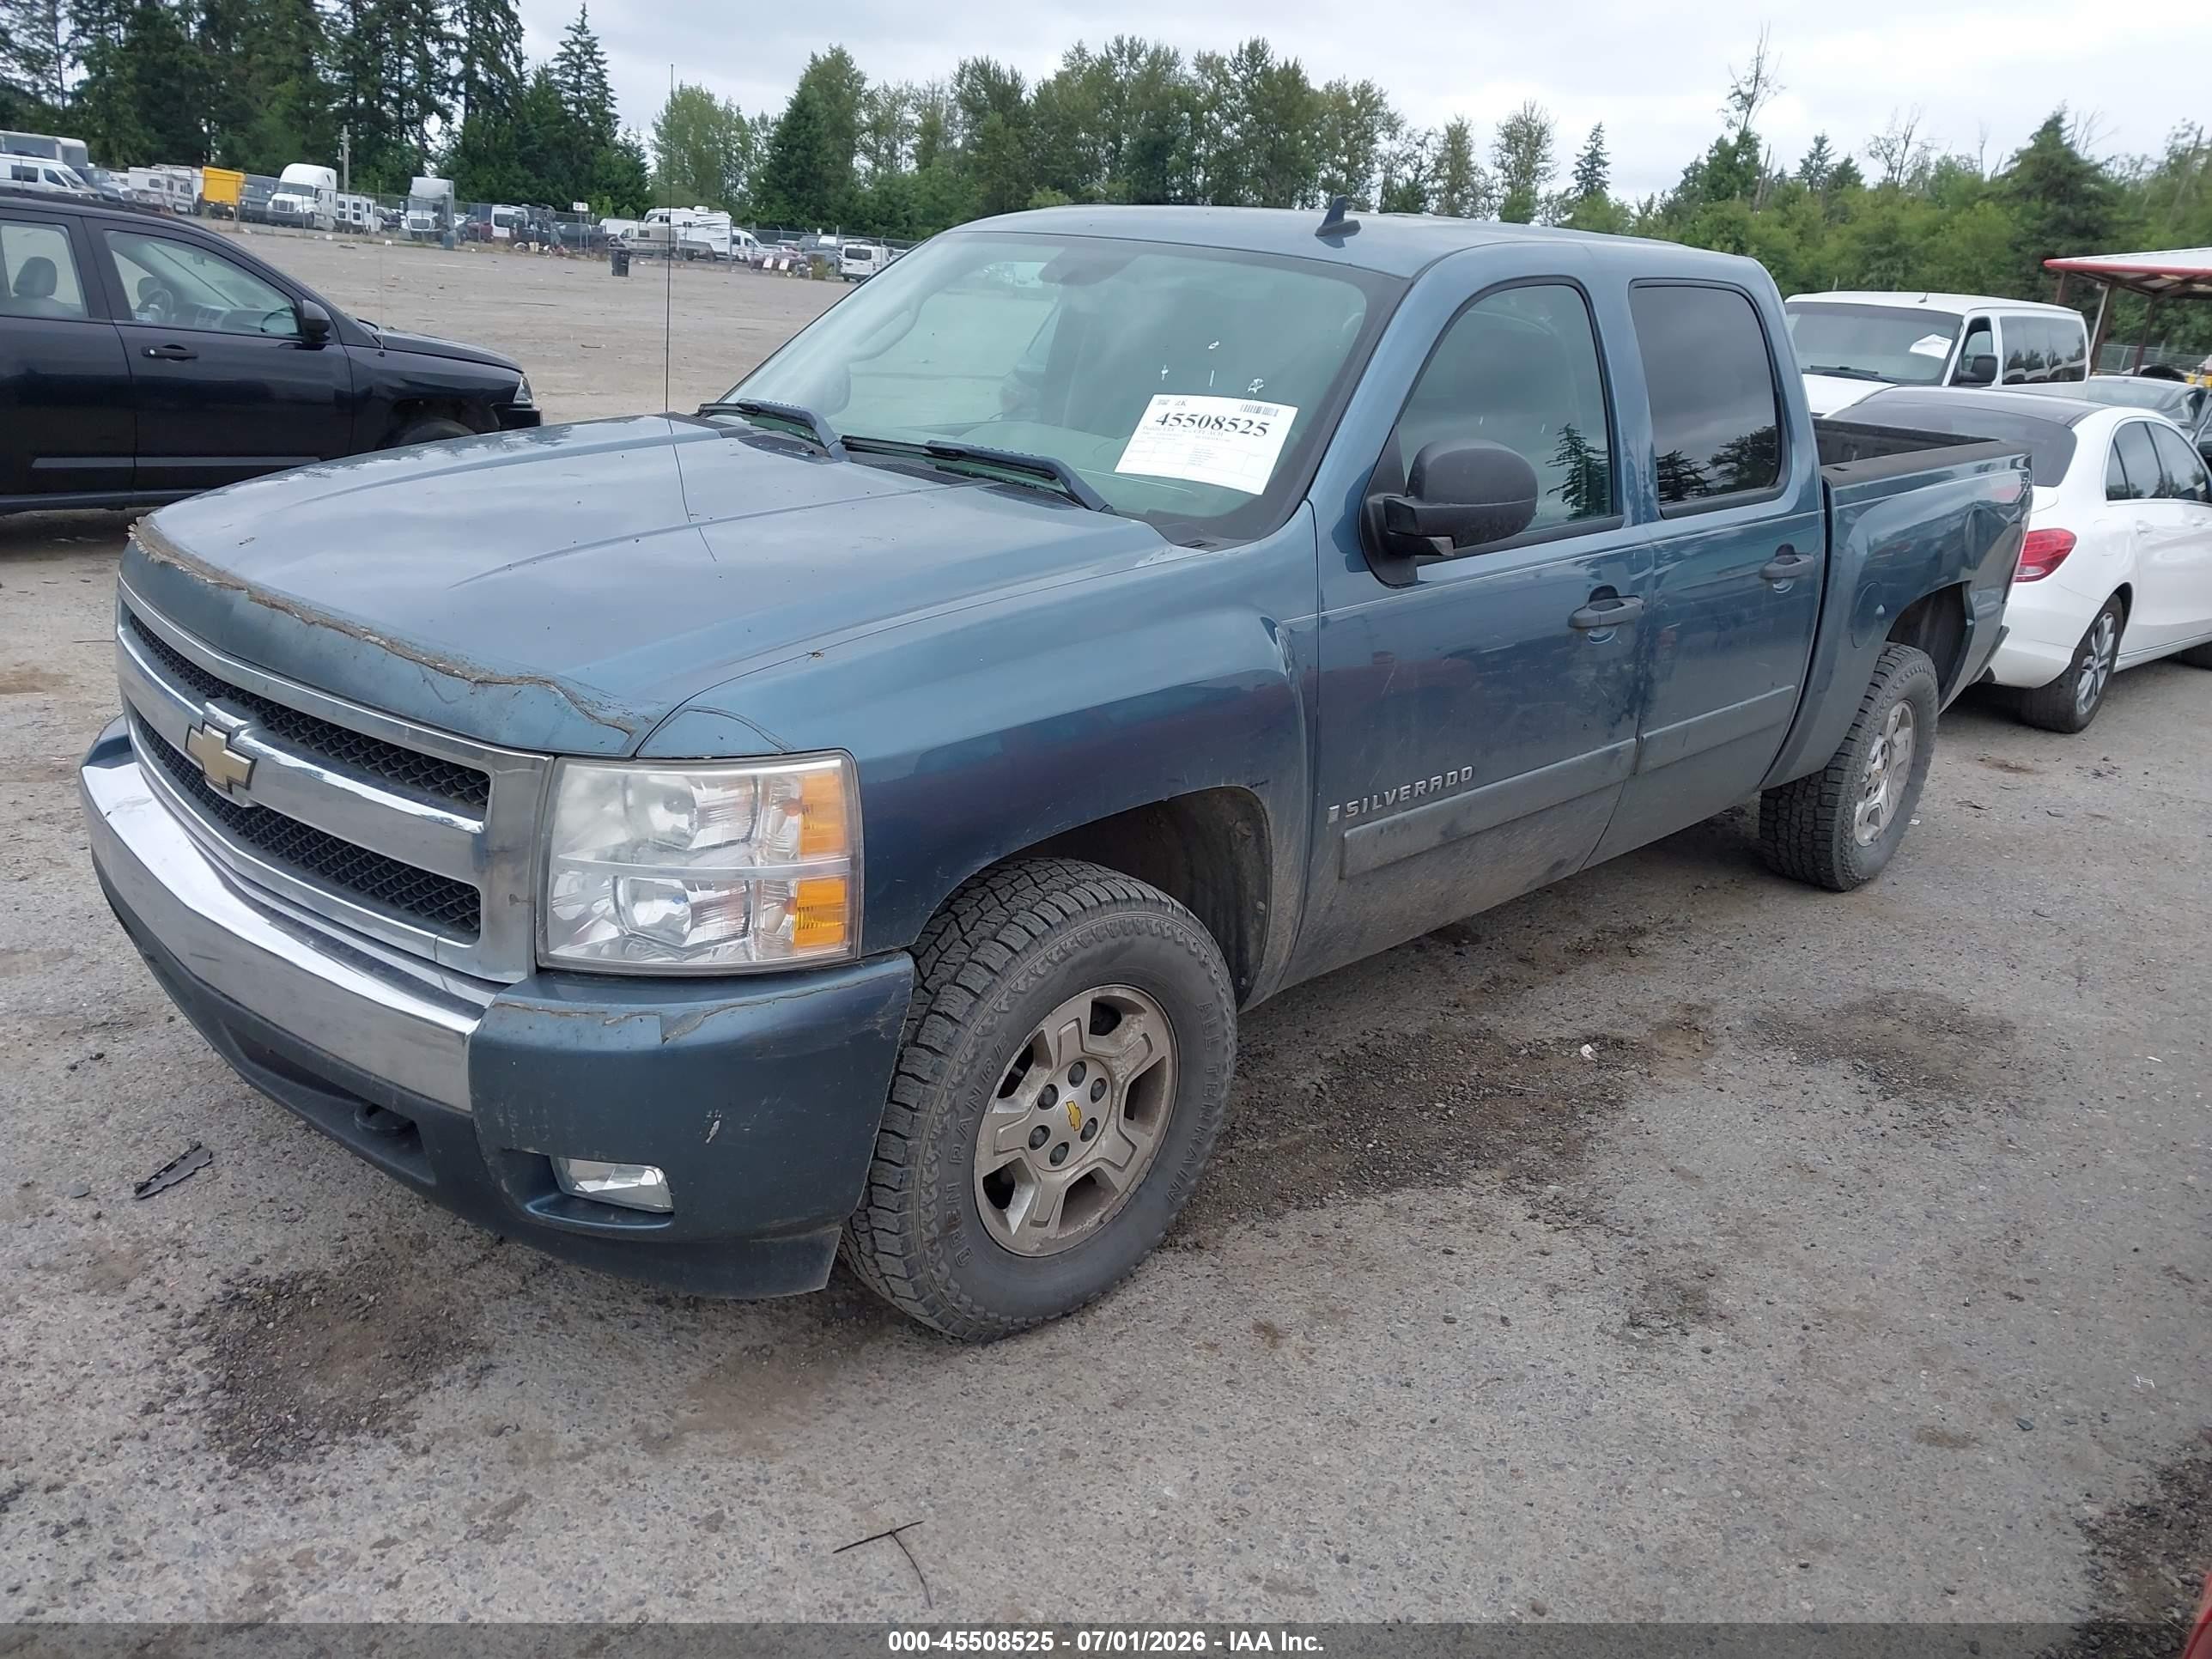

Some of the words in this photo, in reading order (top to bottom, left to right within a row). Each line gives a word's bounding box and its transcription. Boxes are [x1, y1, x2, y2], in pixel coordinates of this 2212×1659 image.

[1156, 412, 1270, 437] 45508525
[1345, 766, 1474, 817] SILVERADO
[1195, 1002, 1220, 1052] ALL
[949, 1032, 1008, 1164] RANGE
[946, 1181, 974, 1267] OPEN
